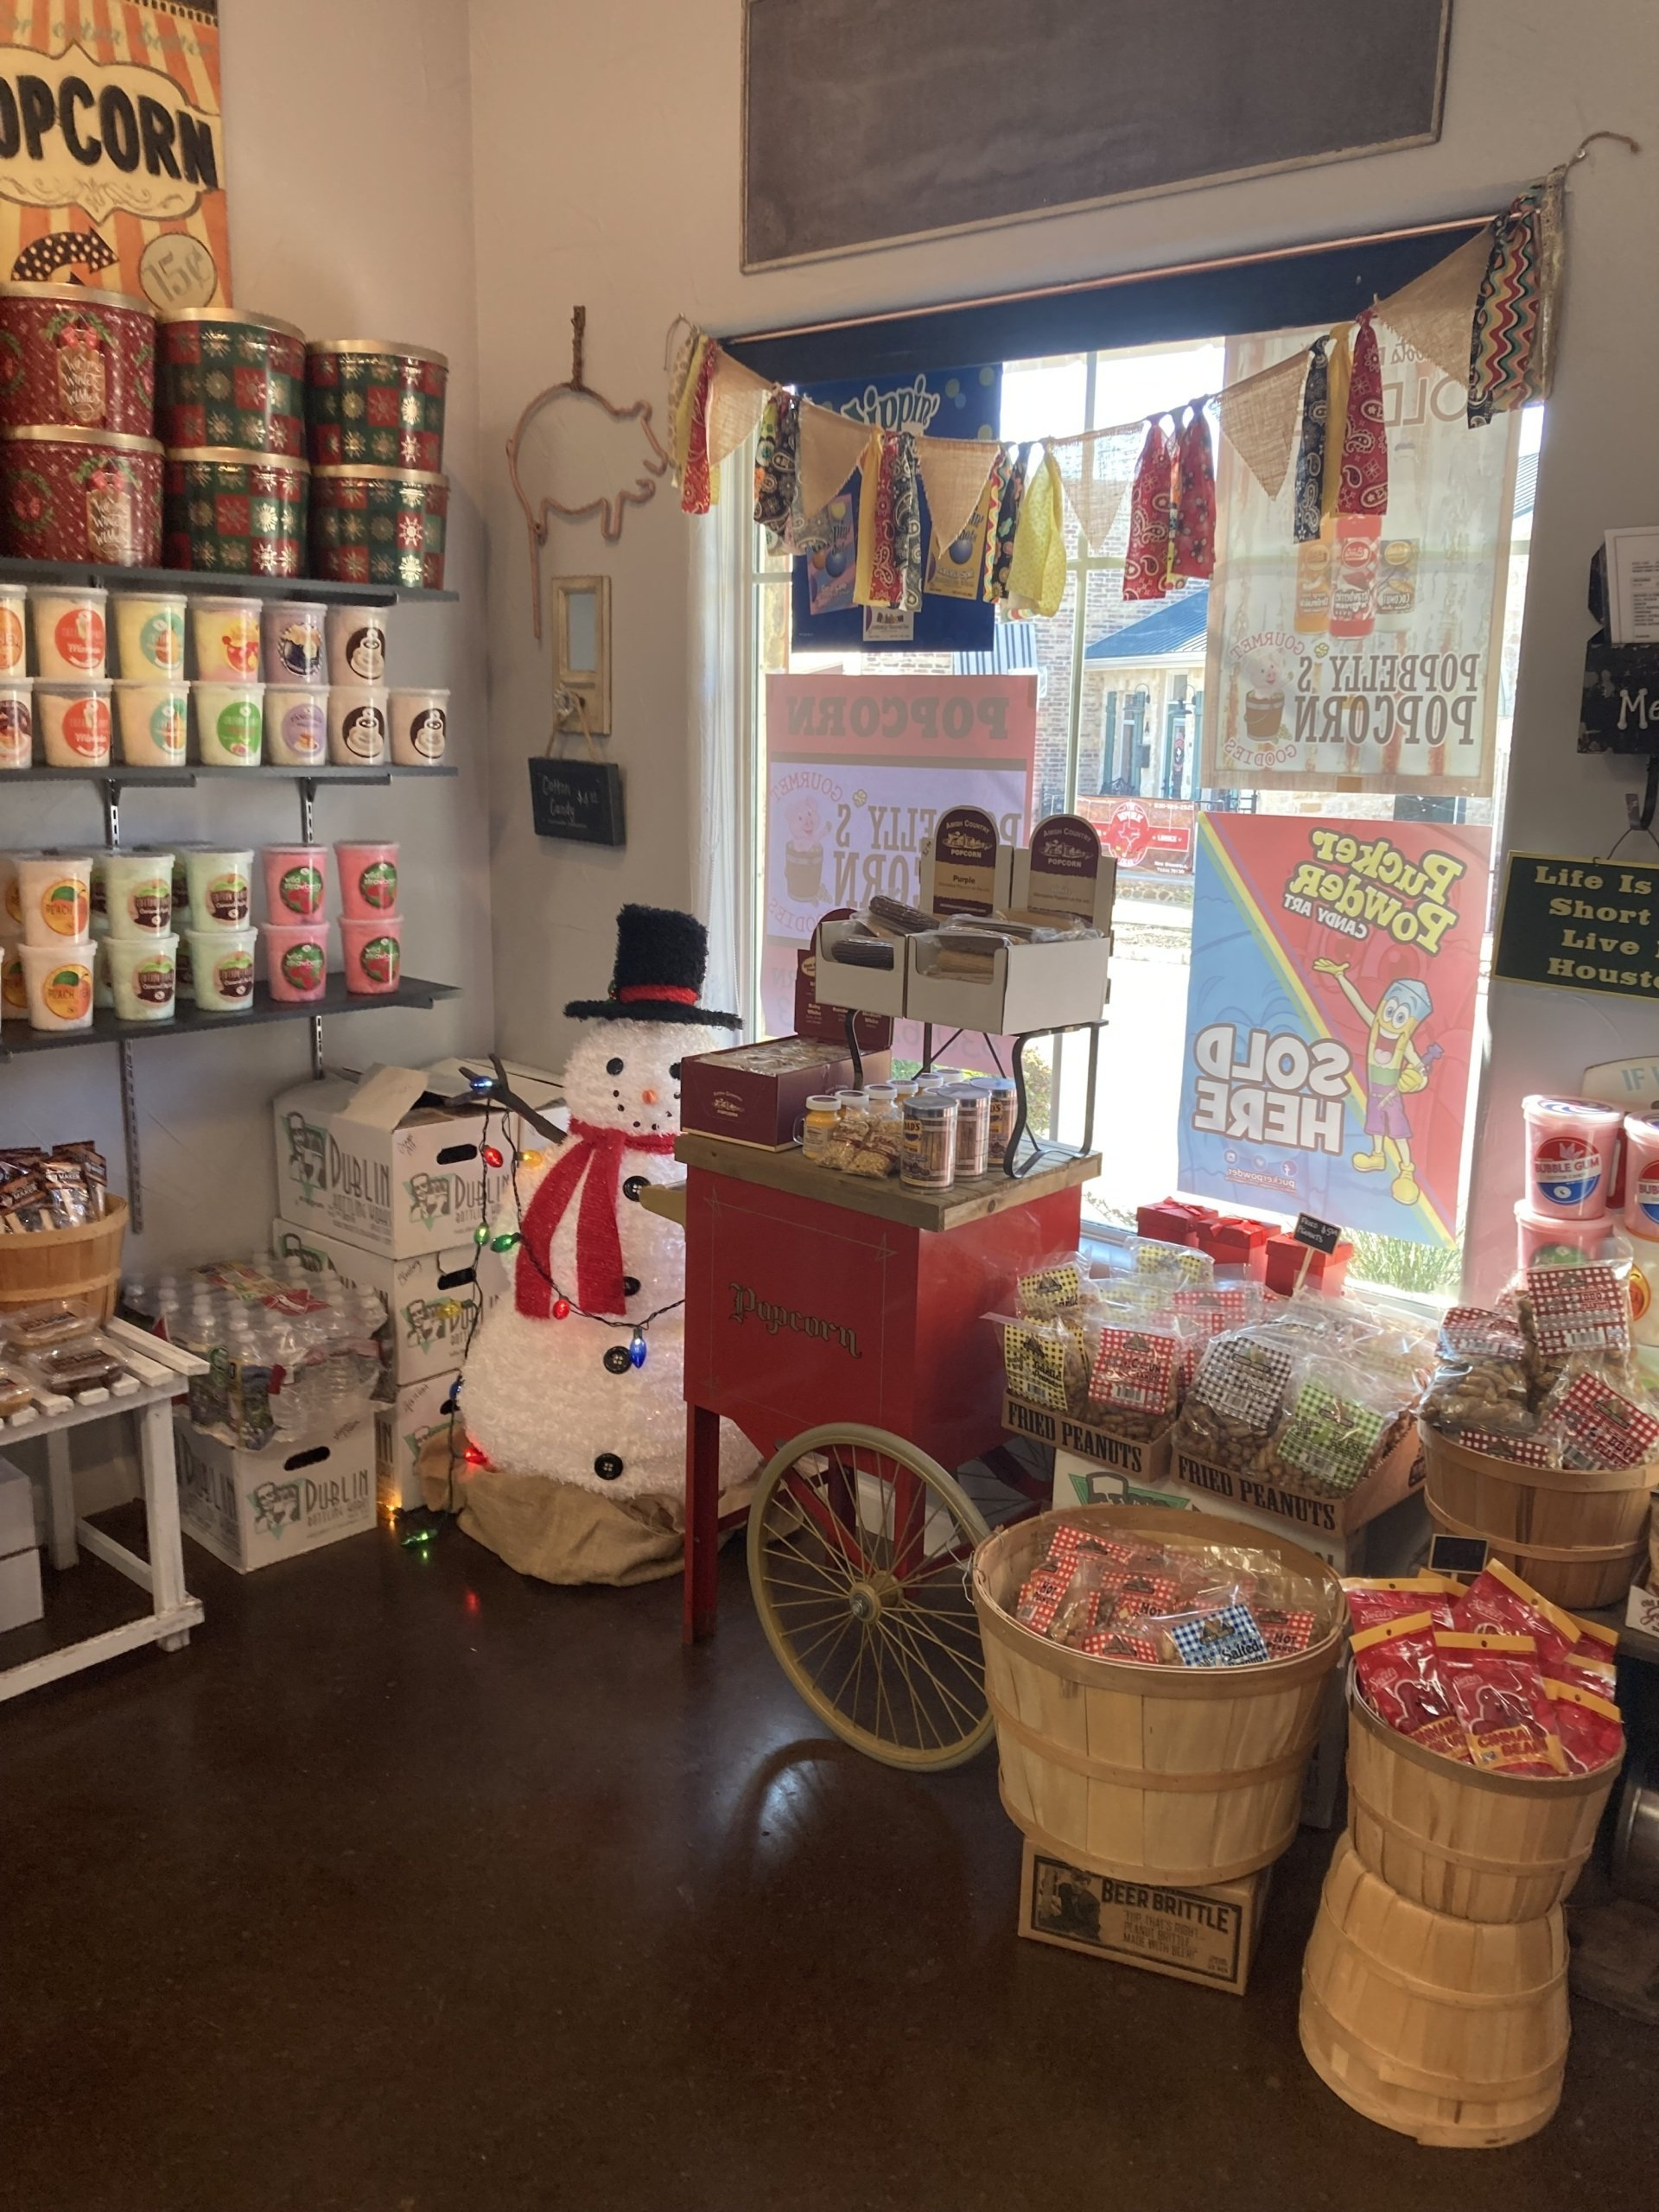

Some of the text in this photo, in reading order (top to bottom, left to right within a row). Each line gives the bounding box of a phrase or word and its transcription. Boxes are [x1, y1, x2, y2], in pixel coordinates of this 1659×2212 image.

[945, 819, 990, 834] AMISH COUNTRY
[1064, 828, 1091, 842] COUNTRY
[950, 849, 982, 858] POPCORN
[1047, 857, 1082, 868] POPCORN
[952, 874, 976, 885] Purple
[1535, 866, 1652, 895] Life Is
[1548, 898, 1651, 925] Short
[1560, 929, 1640, 956] Live
[1621, 1068, 1646, 1091] IF
[327, 1132, 391, 1208] DUBLIN
[1535, 1156, 1599, 1173] BUBBLE GUM
[728, 1281, 862, 1358] Popcorn
[1008, 1401, 1142, 1474] FRIED PEANUTS
[305, 1470, 369, 1510] DUBLIN
[1178, 1455, 1335, 1531] FRIED PEANUTS
[1041, 1580, 1058, 1596] HOT
[1140, 1601, 1163, 1617] HOT
[1274, 1633, 1298, 1644] HOT
[1221, 1641, 1261, 1662] Salted
[1102, 1878, 1229, 1935] BEER BRITTLE
